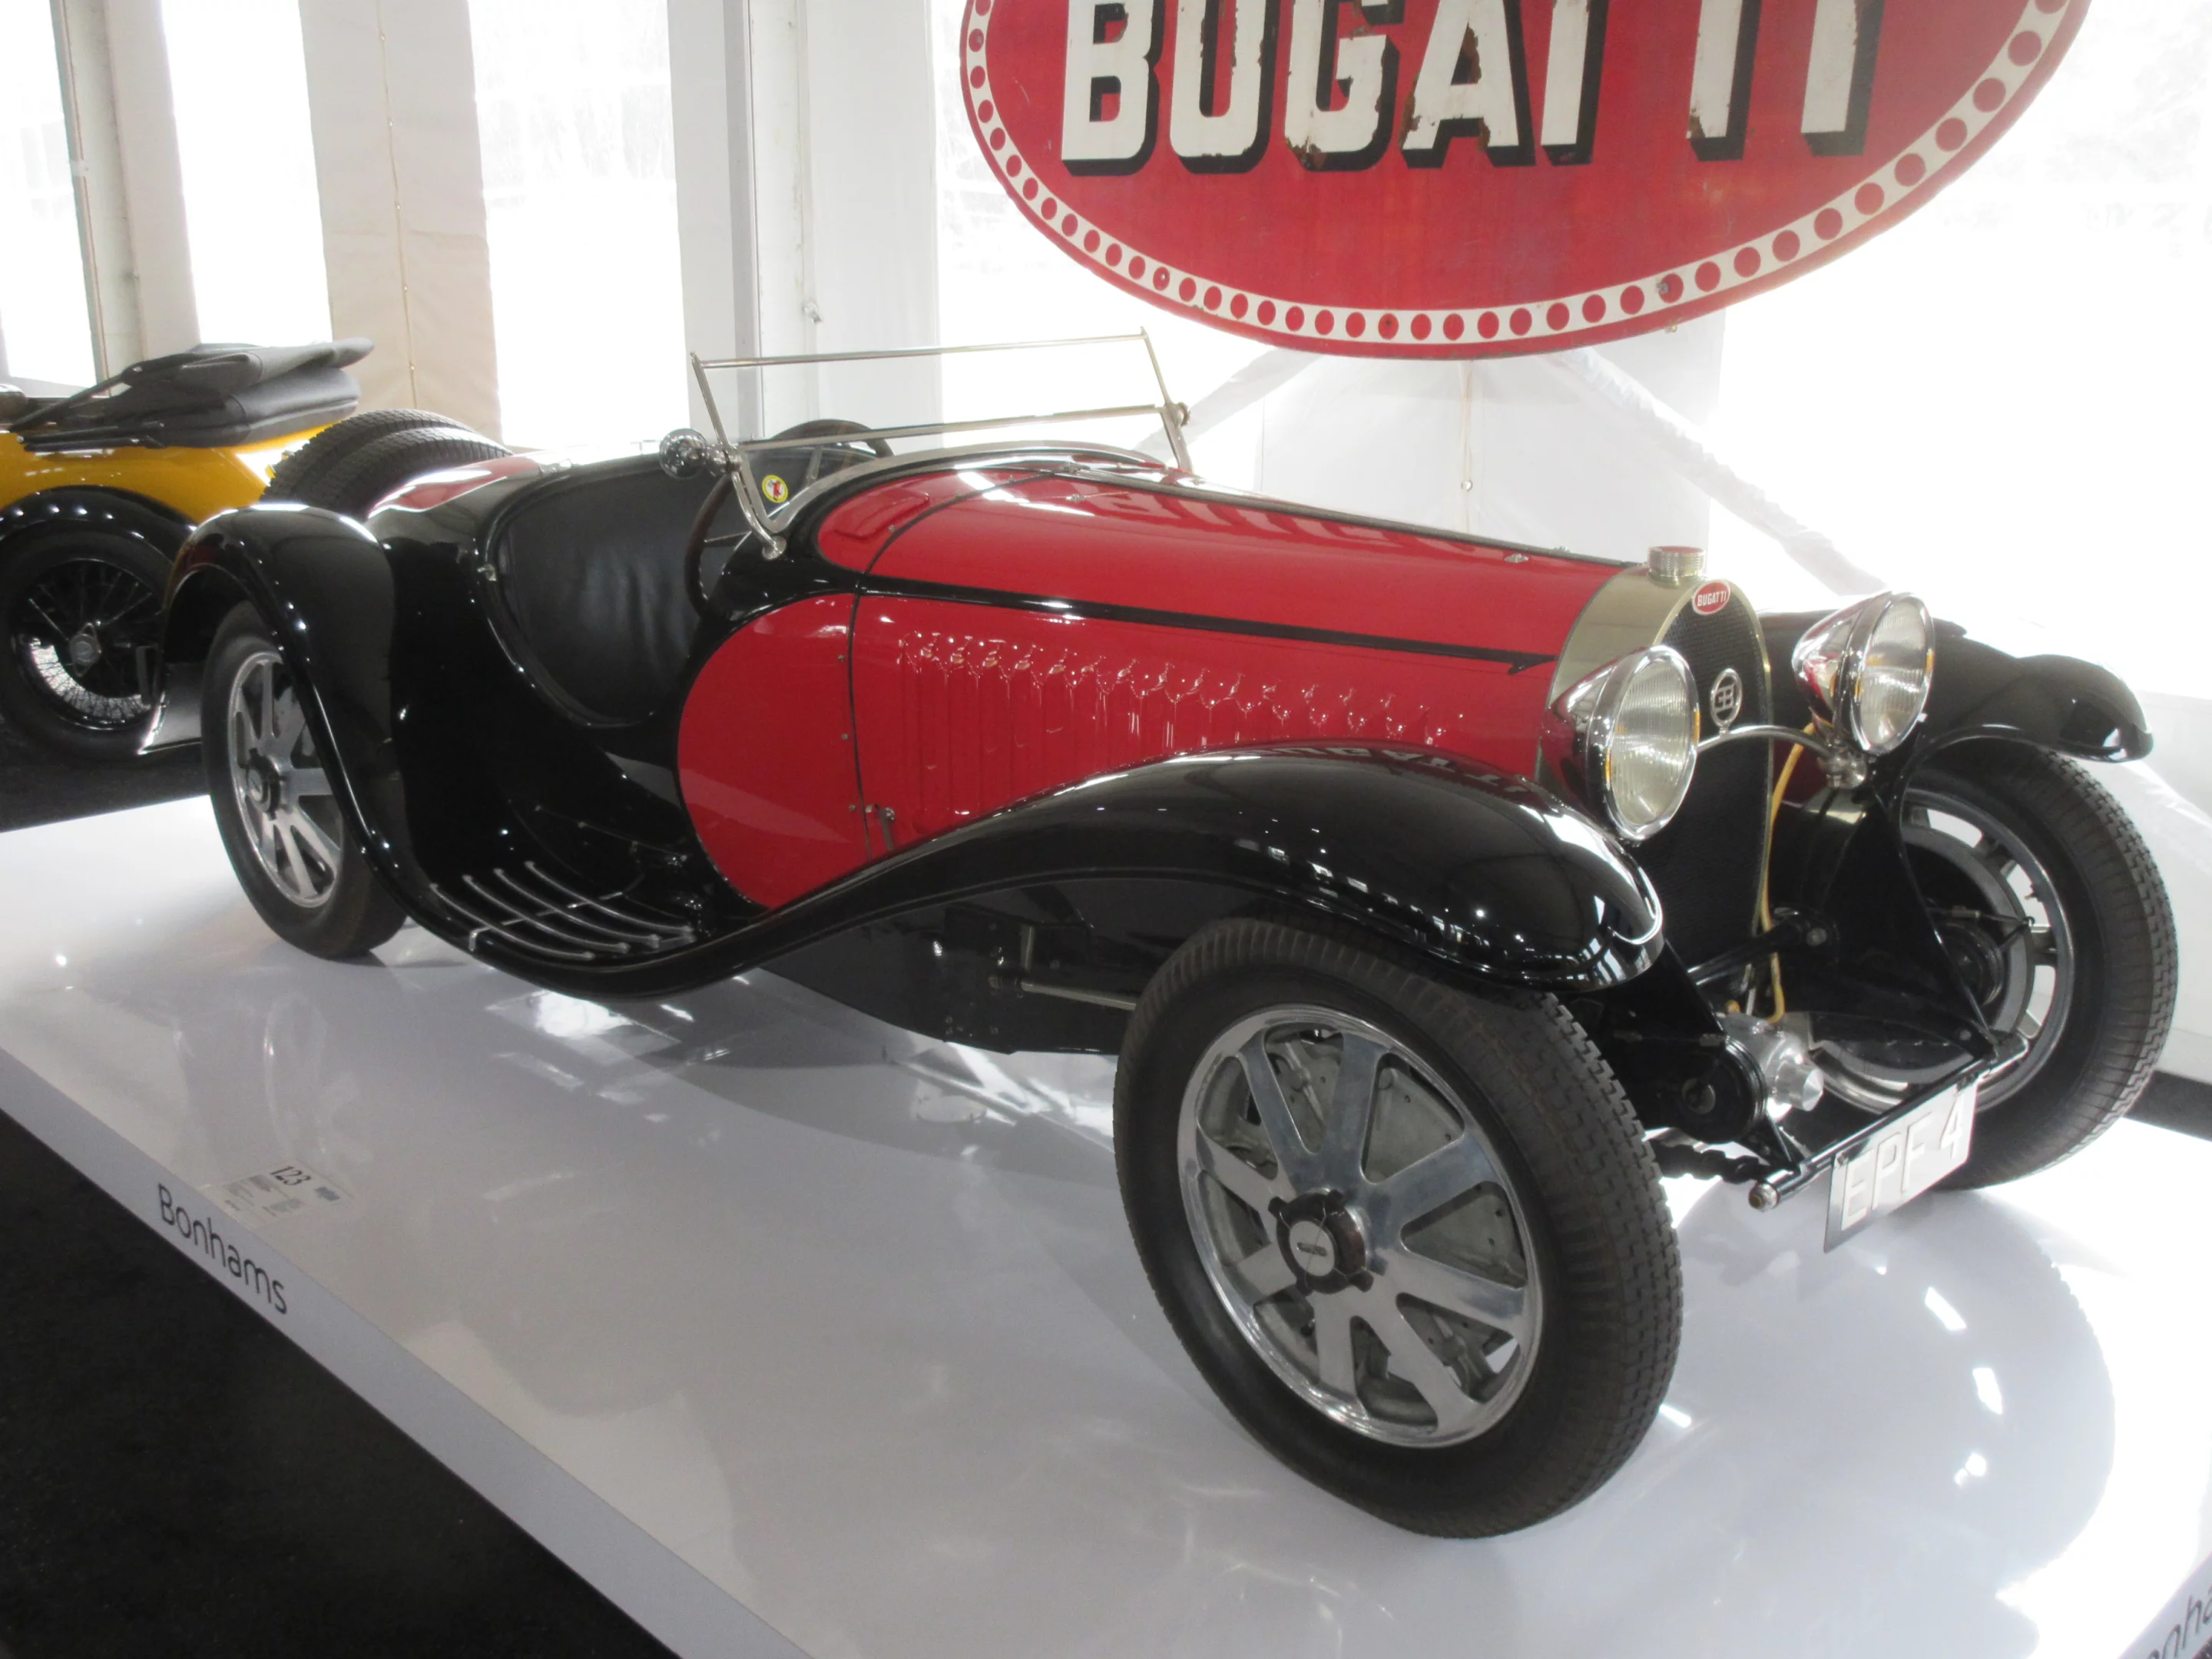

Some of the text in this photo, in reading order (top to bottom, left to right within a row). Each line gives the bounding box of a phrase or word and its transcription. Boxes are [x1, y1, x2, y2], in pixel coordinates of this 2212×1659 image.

[1697, 590, 1727, 607] BUGATTI
[270, 1165, 312, 1187] 123
[1841, 1089, 1966, 1230] EPF 4
[157, 1183, 288, 1315] Bonhams
